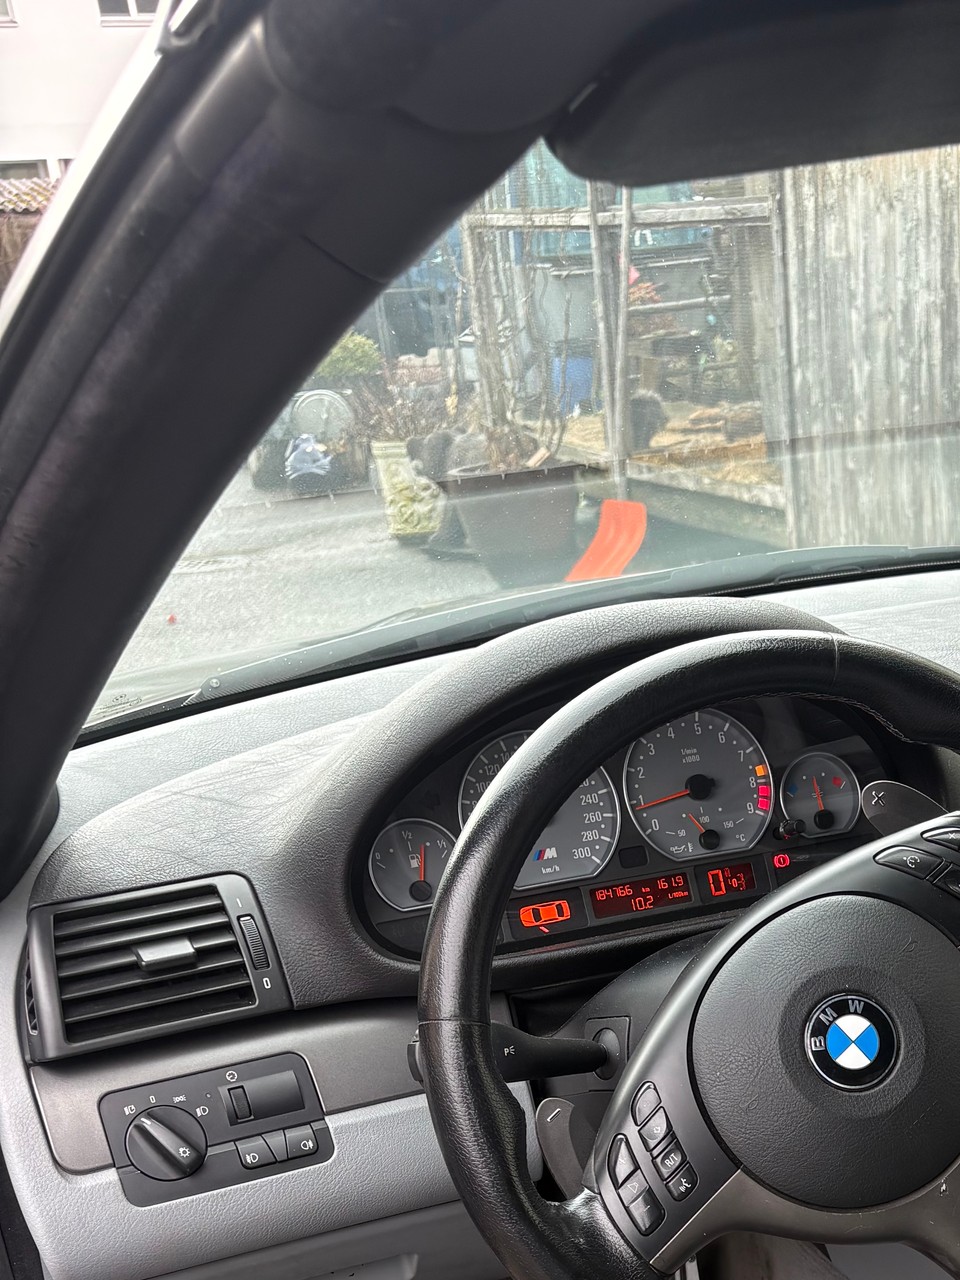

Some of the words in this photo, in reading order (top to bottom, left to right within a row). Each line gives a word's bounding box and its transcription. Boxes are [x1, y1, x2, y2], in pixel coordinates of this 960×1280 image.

[667, 727, 675, 739] 4
[694, 723, 702, 735] 5
[718, 732, 725, 744] 6
[647, 743, 655, 755] 3
[738, 750, 744, 762] 7
[485, 764, 500, 776] 120
[637, 767, 645, 779] 2
[749, 777, 757, 788] 8
[580, 793, 599, 806] 240
[638, 795, 644, 806] 1
[746, 803, 754, 814] 9
[583, 811, 602, 824] 260
[652, 819, 660, 831] 0
[723, 821, 734, 829] 150
[581, 829, 600, 842] 280
[677, 829, 686, 837] 50
[572, 846, 591, 859] 300
[541, 865, 560, 874] km/h
[595, 885, 633, 901] 184766
[631, 895, 654, 911] 10.2
[811, 1000, 864, 1051] BMW
[664, 1152, 678, 1168] R/T
